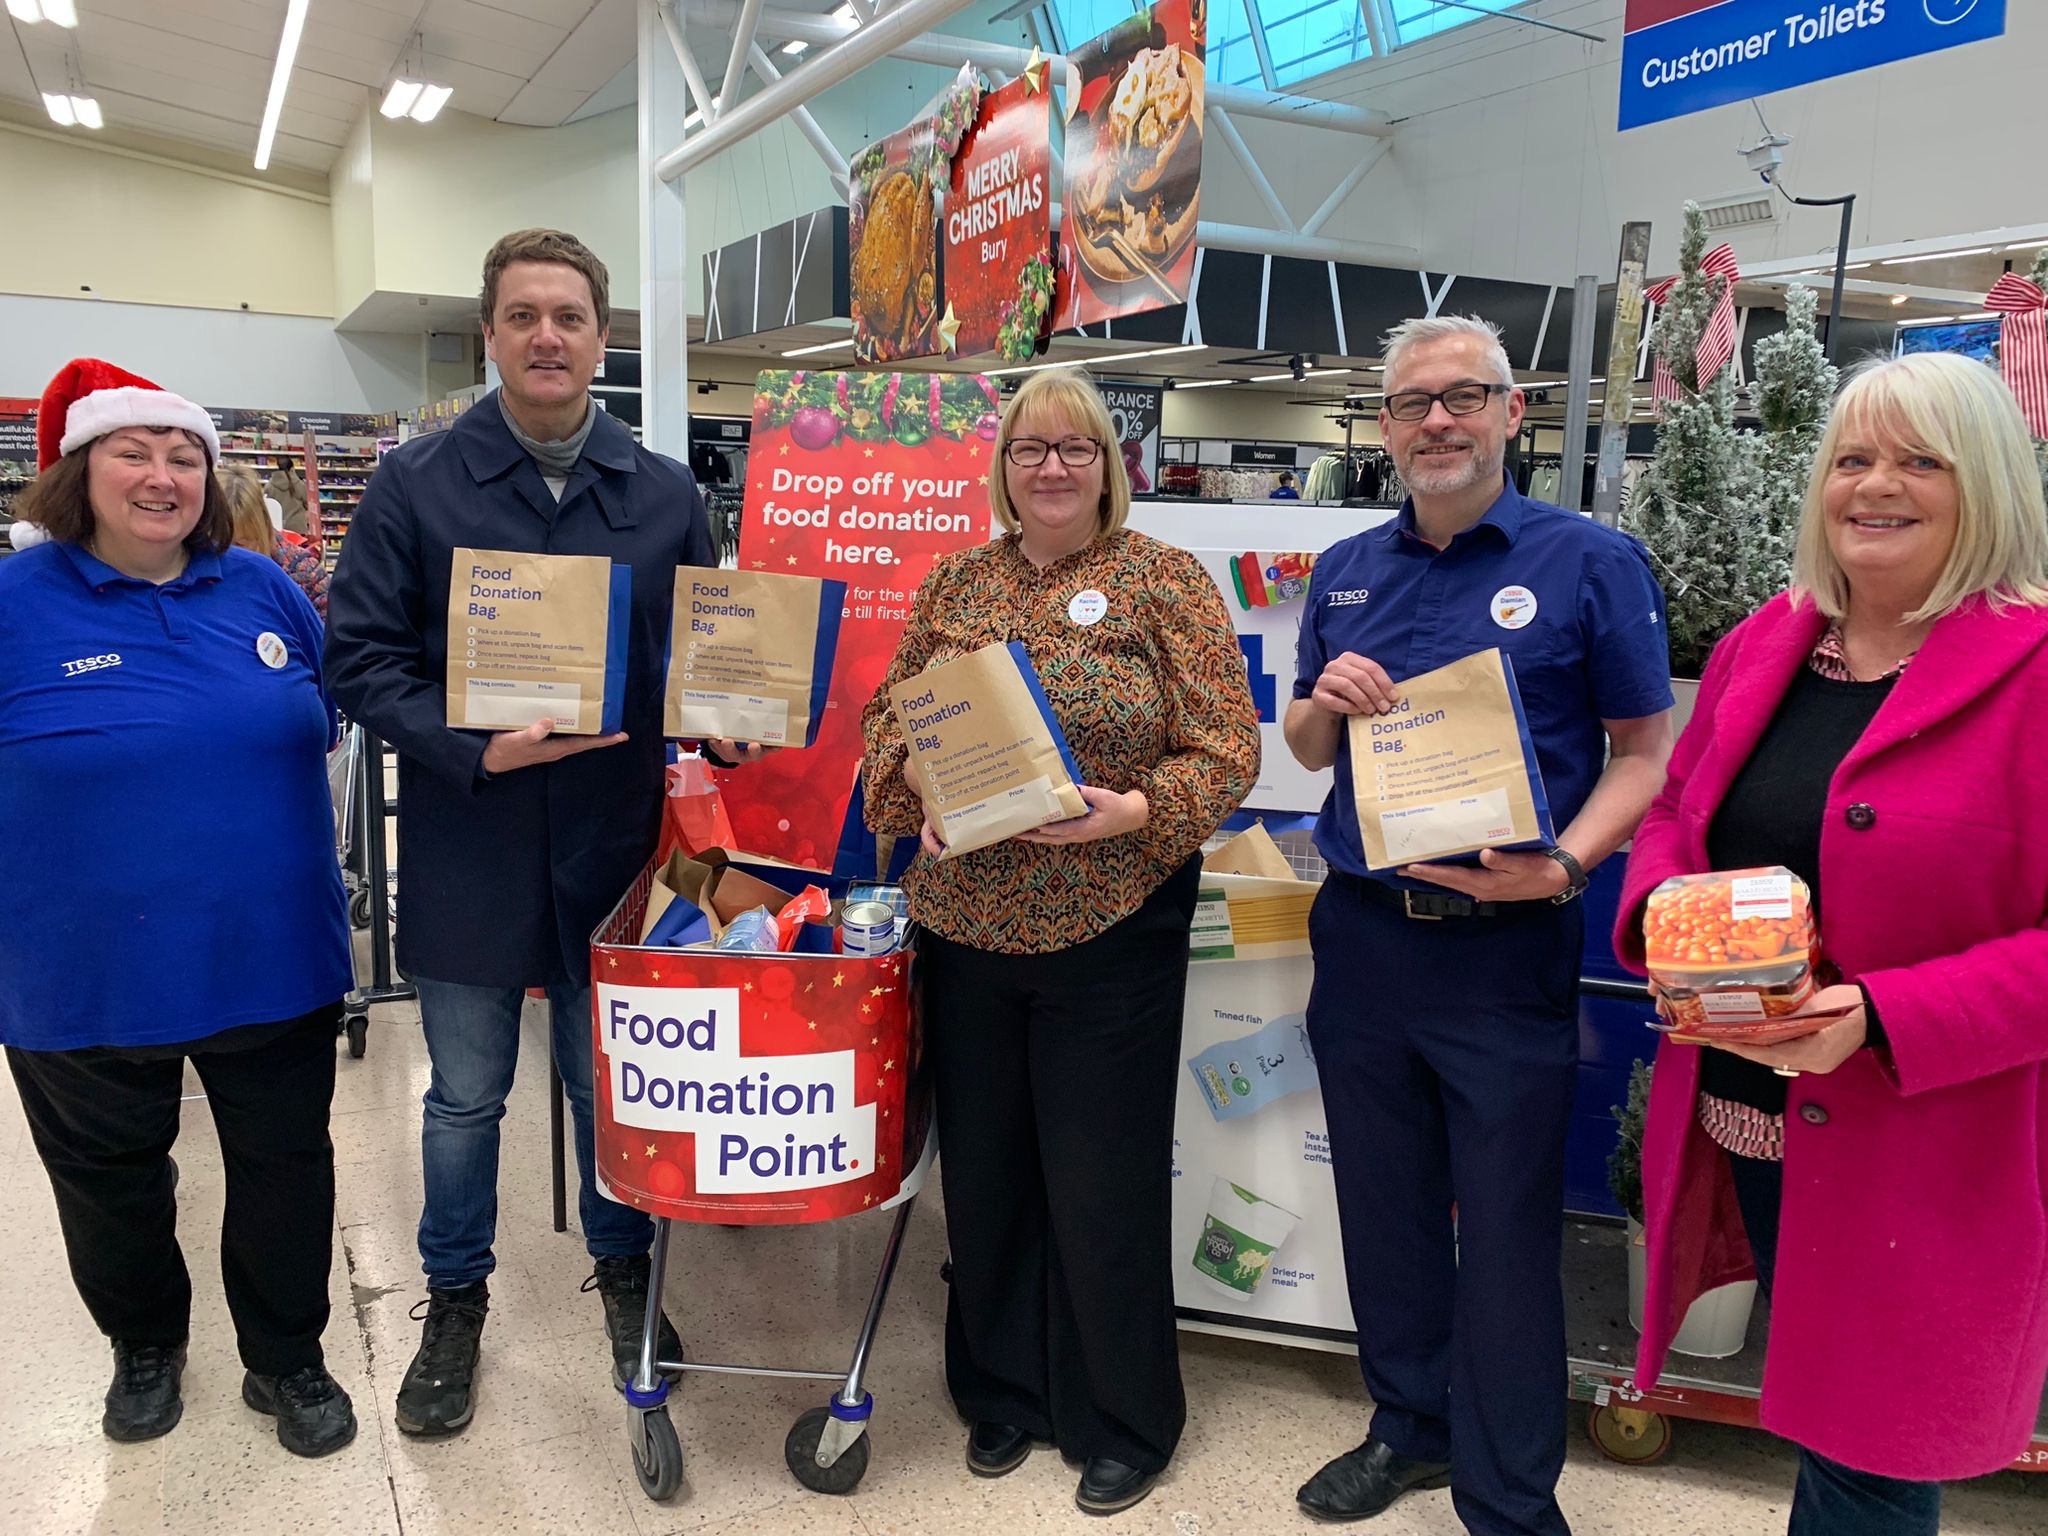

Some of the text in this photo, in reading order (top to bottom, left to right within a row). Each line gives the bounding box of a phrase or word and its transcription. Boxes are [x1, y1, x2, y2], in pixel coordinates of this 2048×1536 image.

[1641, 1, 1886, 88] Customer Toilets
[968, 146, 1022, 201] MERRY
[949, 173, 1042, 246] CHRISTMAS
[981, 236, 1008, 264] Bury
[1128, 430, 1142, 439] OFF
[16, 442, 30, 450] five
[1254, 451, 1276, 459] Women
[772, 468, 969, 502] Drop off your
[762, 502, 970, 532] food donation
[825, 539, 901, 565] here.
[472, 566, 512, 580] Food
[470, 584, 542, 600] Donation
[692, 582, 729, 597] Food
[854, 586, 876, 600] for
[879, 588, 904, 601] the
[1328, 589, 1368, 603] TESCO
[468, 603, 500, 619] Bag.
[692, 601, 755, 618] Donation
[855, 606, 872, 618] till
[691, 619, 718, 635] Bag.
[61, 654, 121, 673] TESCO
[901, 689, 935, 714] Food
[908, 699, 971, 733] Donation
[1371, 708, 1445, 736] Donation
[915, 733, 944, 752] Bag.
[1373, 739, 1407, 754] Bag.
[953, 746, 977, 758] donation
[1009, 788, 1025, 798] Price:
[1488, 827, 1510, 836] TESCO
[1214, 1009, 1262, 1024] Tinned fish
[610, 1000, 716, 1051] Food
[1256, 1055, 1271, 1076] Pack
[1267, 1053, 1284, 1068] 3
[622, 1061, 834, 1115] Donation
[1305, 1131, 1320, 1140] Tea
[719, 1133, 858, 1178] Point.
[1208, 1240, 1230, 1253] FOOD
[1272, 1267, 1315, 1281] Dried pot
[1272, 1278, 1298, 1287] meals
